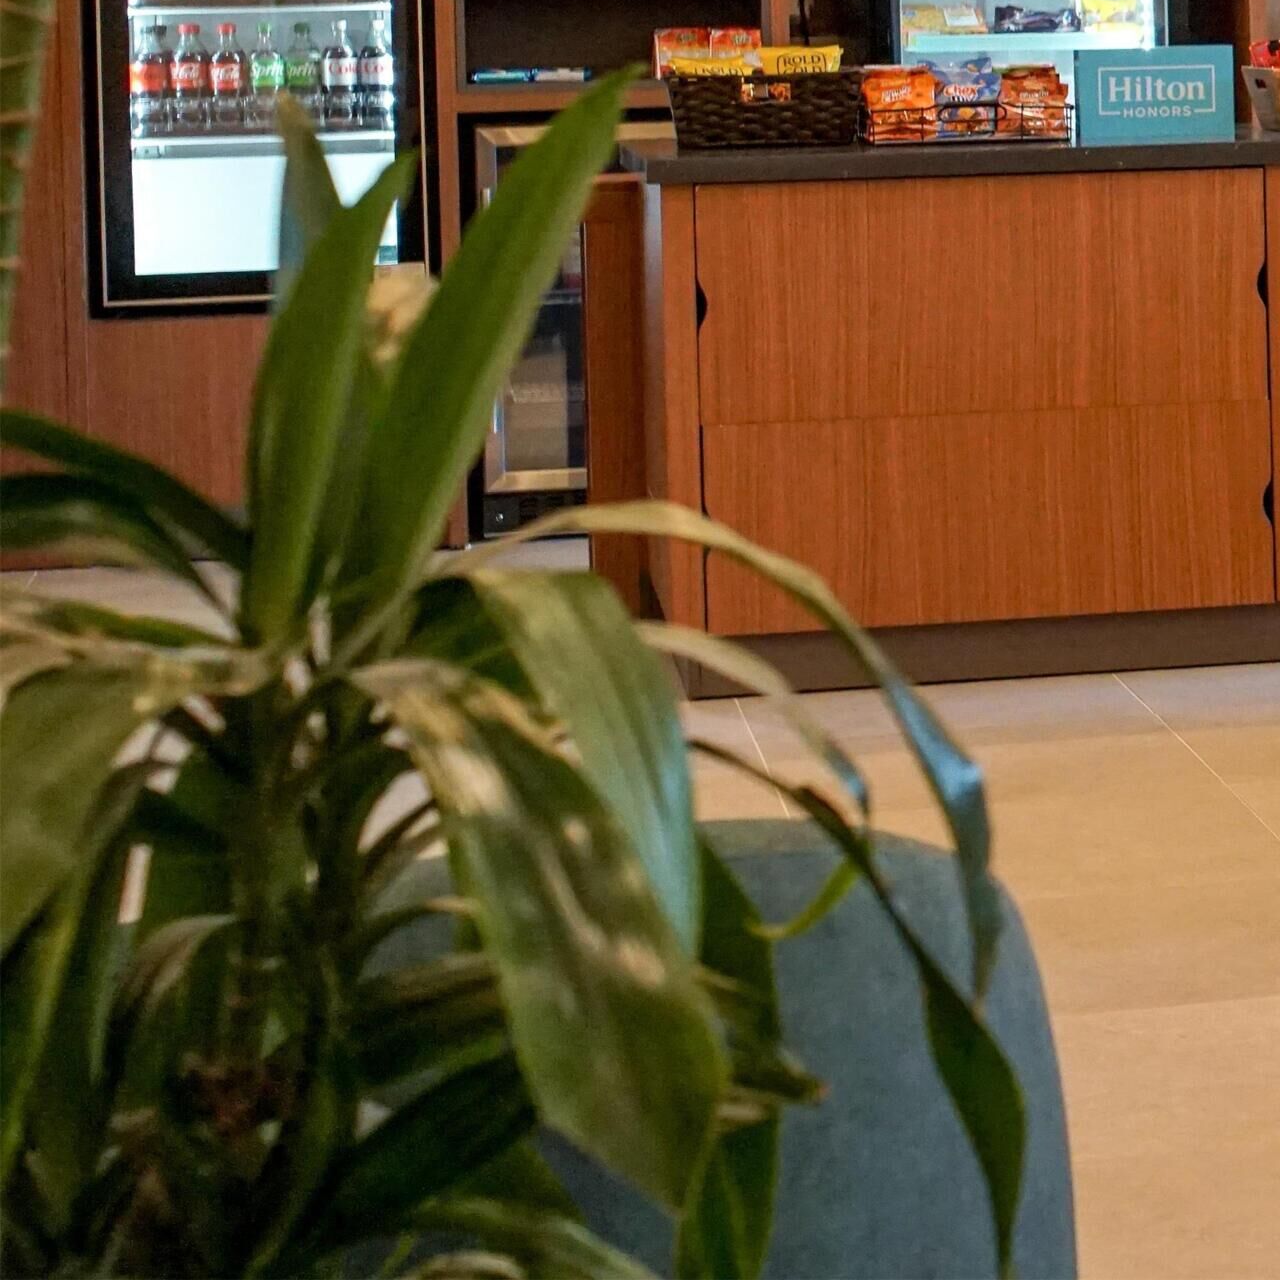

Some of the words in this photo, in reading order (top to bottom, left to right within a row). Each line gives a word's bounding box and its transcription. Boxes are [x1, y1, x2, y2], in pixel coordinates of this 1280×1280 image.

[783, 54, 821, 68] ROLD
[1108, 76, 1206, 103] Hilton
[1123, 105, 1192, 119] HONORS
